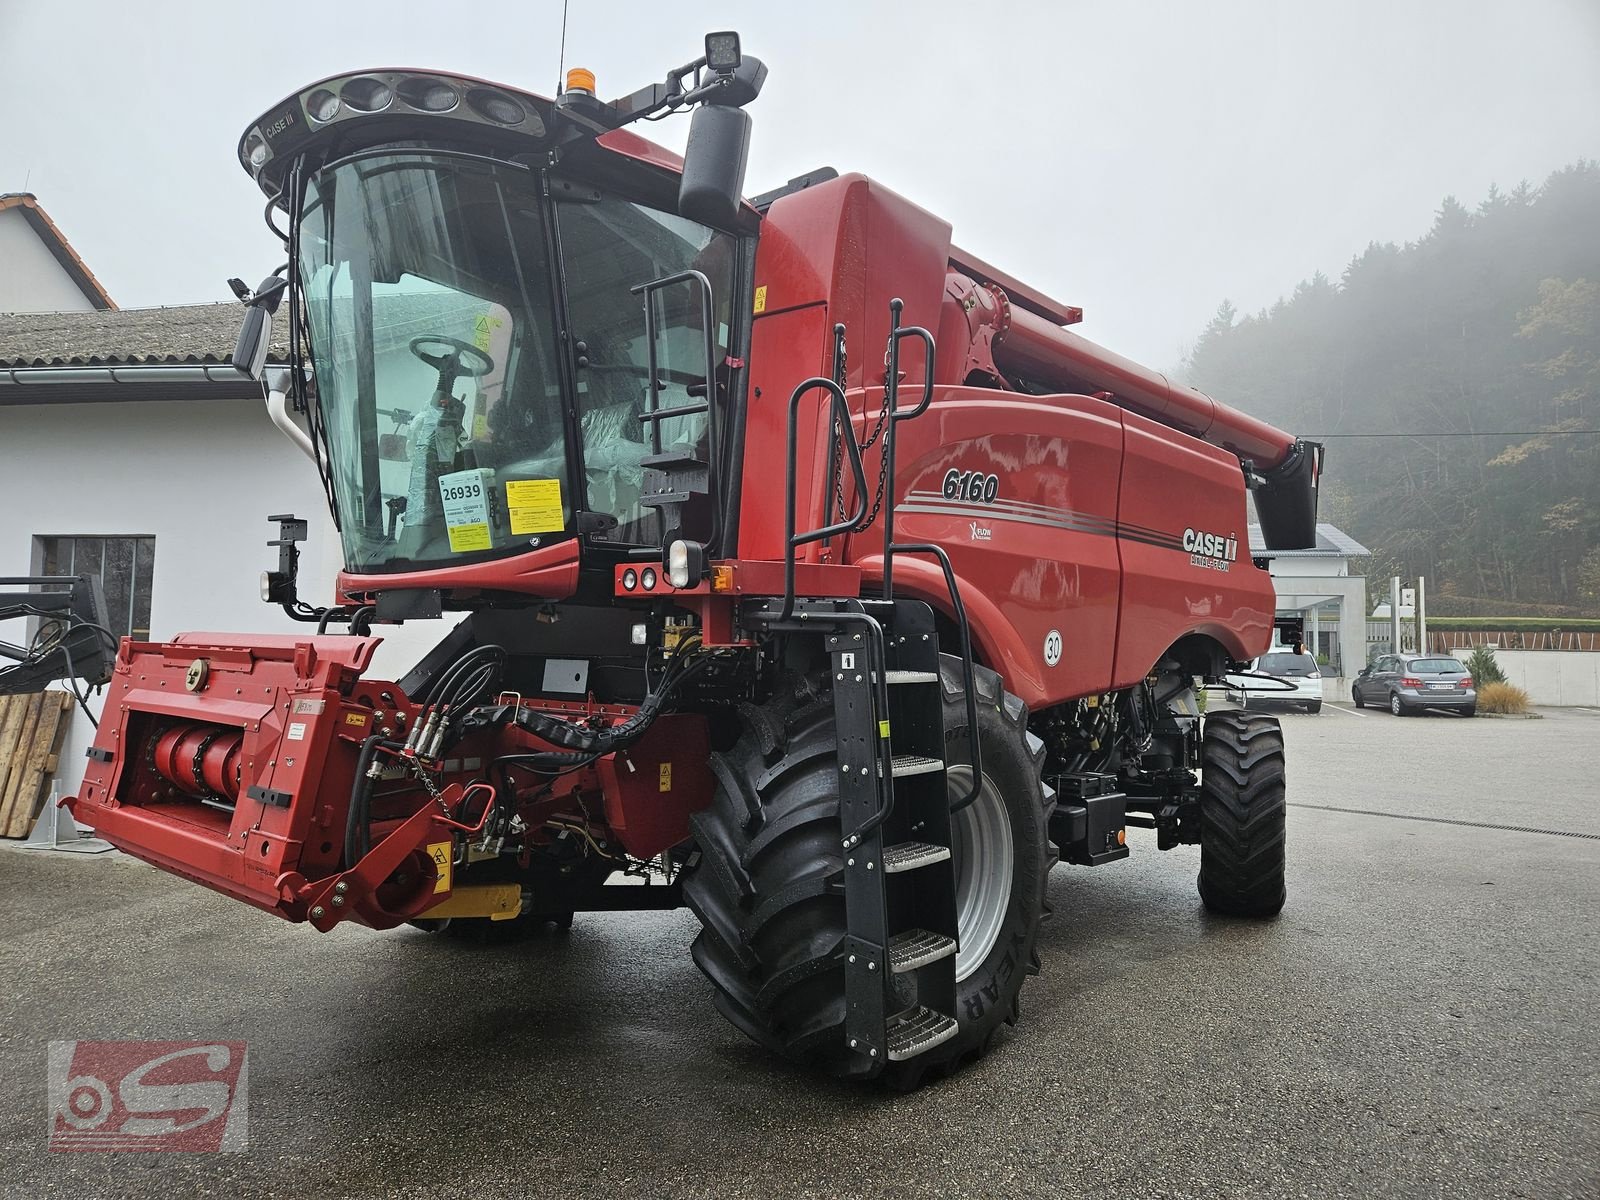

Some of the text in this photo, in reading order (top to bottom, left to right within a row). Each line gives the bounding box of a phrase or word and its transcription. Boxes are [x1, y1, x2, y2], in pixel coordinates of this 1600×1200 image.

[266, 119, 287, 138] CASE
[442, 484, 481, 501] 26939
[942, 467, 999, 505] 6160
[1182, 527, 1225, 559] CASE
[1047, 636, 1060, 660] 30
